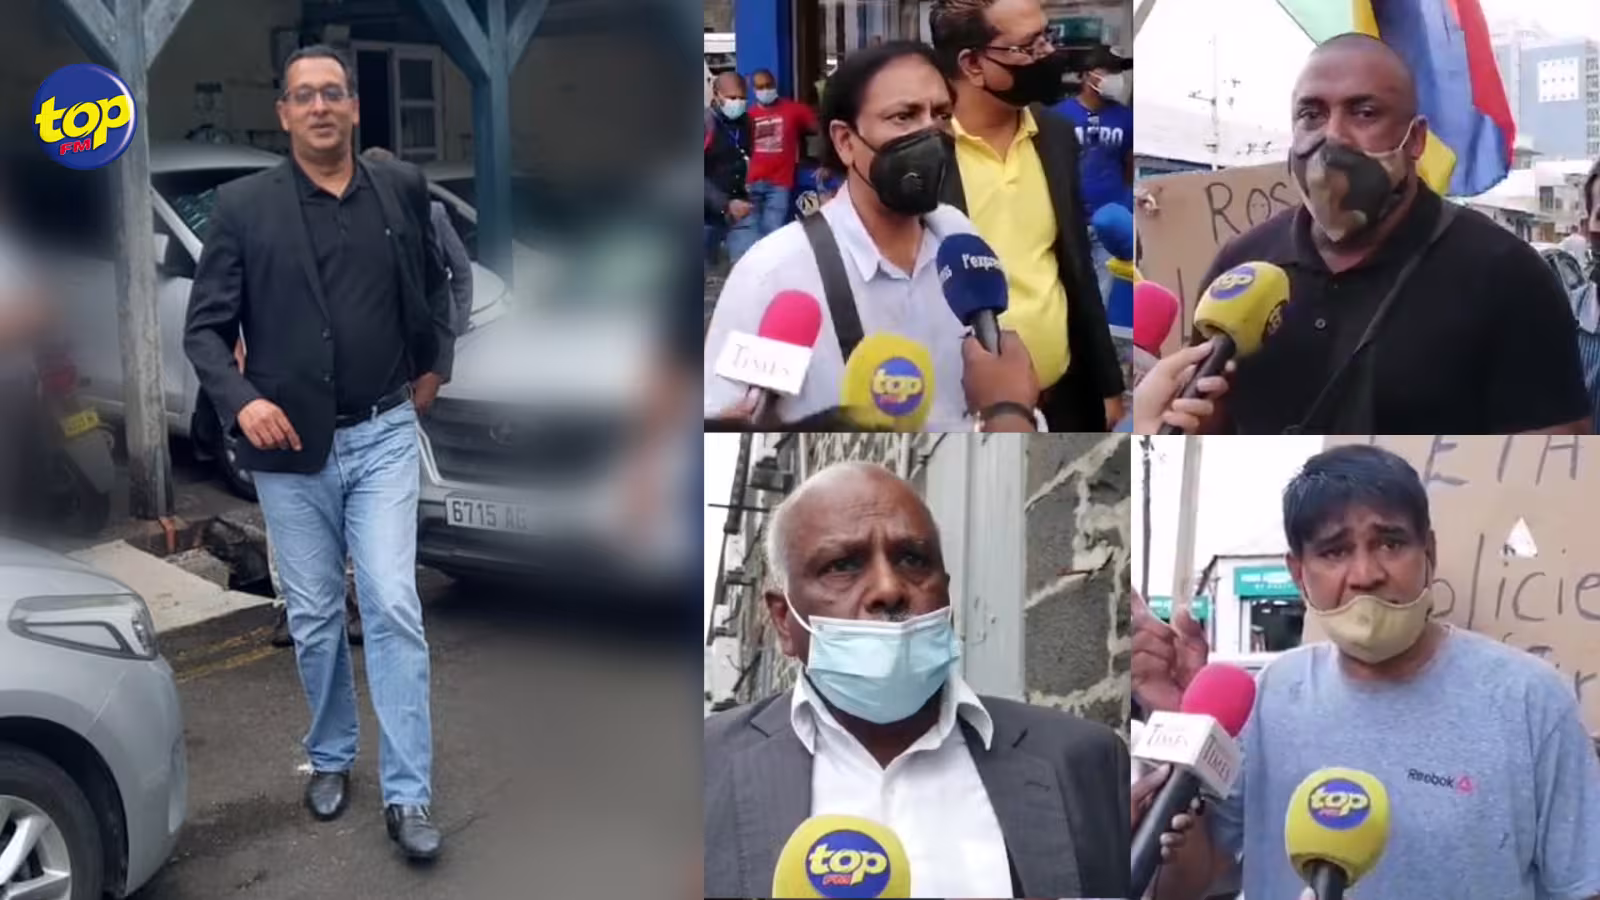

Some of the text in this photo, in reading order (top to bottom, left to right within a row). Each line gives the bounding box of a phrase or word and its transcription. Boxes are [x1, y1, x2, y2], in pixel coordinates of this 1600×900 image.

[452, 500, 497, 528] 6715
[1311, 787, 1368, 816] top
[809, 843, 888, 886] top
